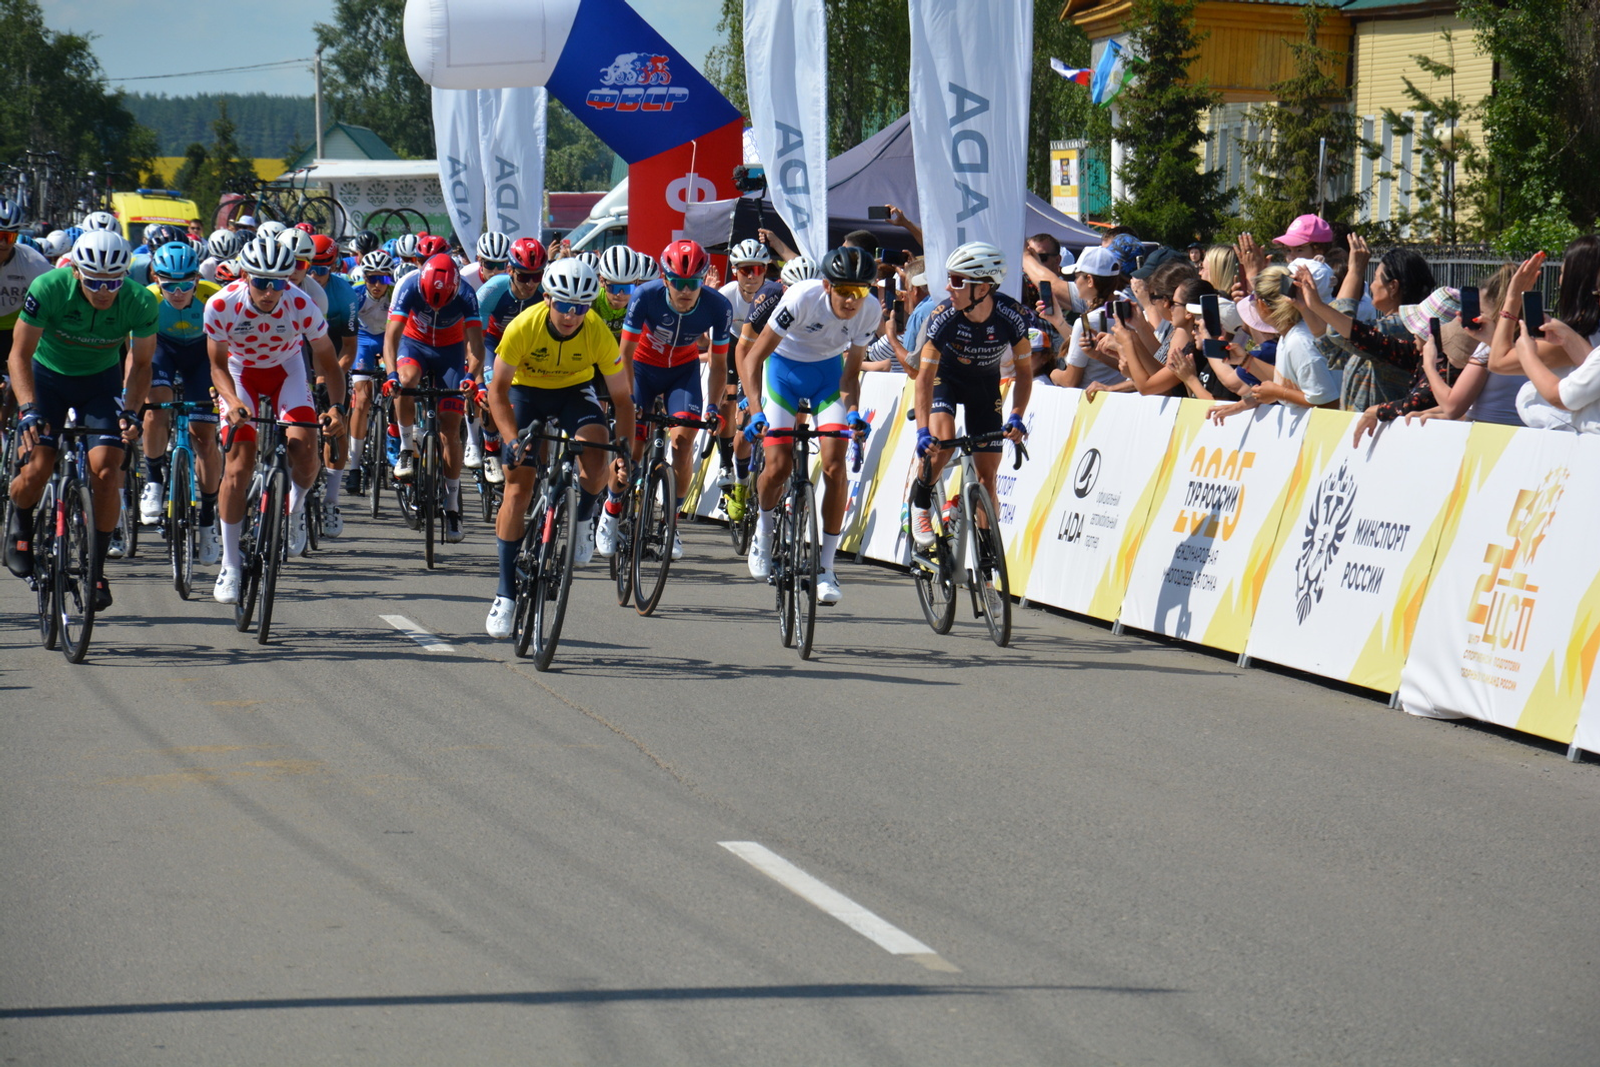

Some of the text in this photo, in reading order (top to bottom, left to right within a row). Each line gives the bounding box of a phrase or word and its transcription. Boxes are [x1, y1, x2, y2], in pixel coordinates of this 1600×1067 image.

[585, 86, 690, 112] ФВСР
[926, 306, 956, 339] Капита
[996, 301, 1026, 337] Капитал
[1184, 481, 1240, 513] ТУР РОССИИ
[1057, 510, 1085, 544] LADA
[1352, 518, 1411, 552] МИНСПОРТ
[1340, 561, 1385, 594] РОССИИ
[1481, 591, 1536, 652] ЦСП
